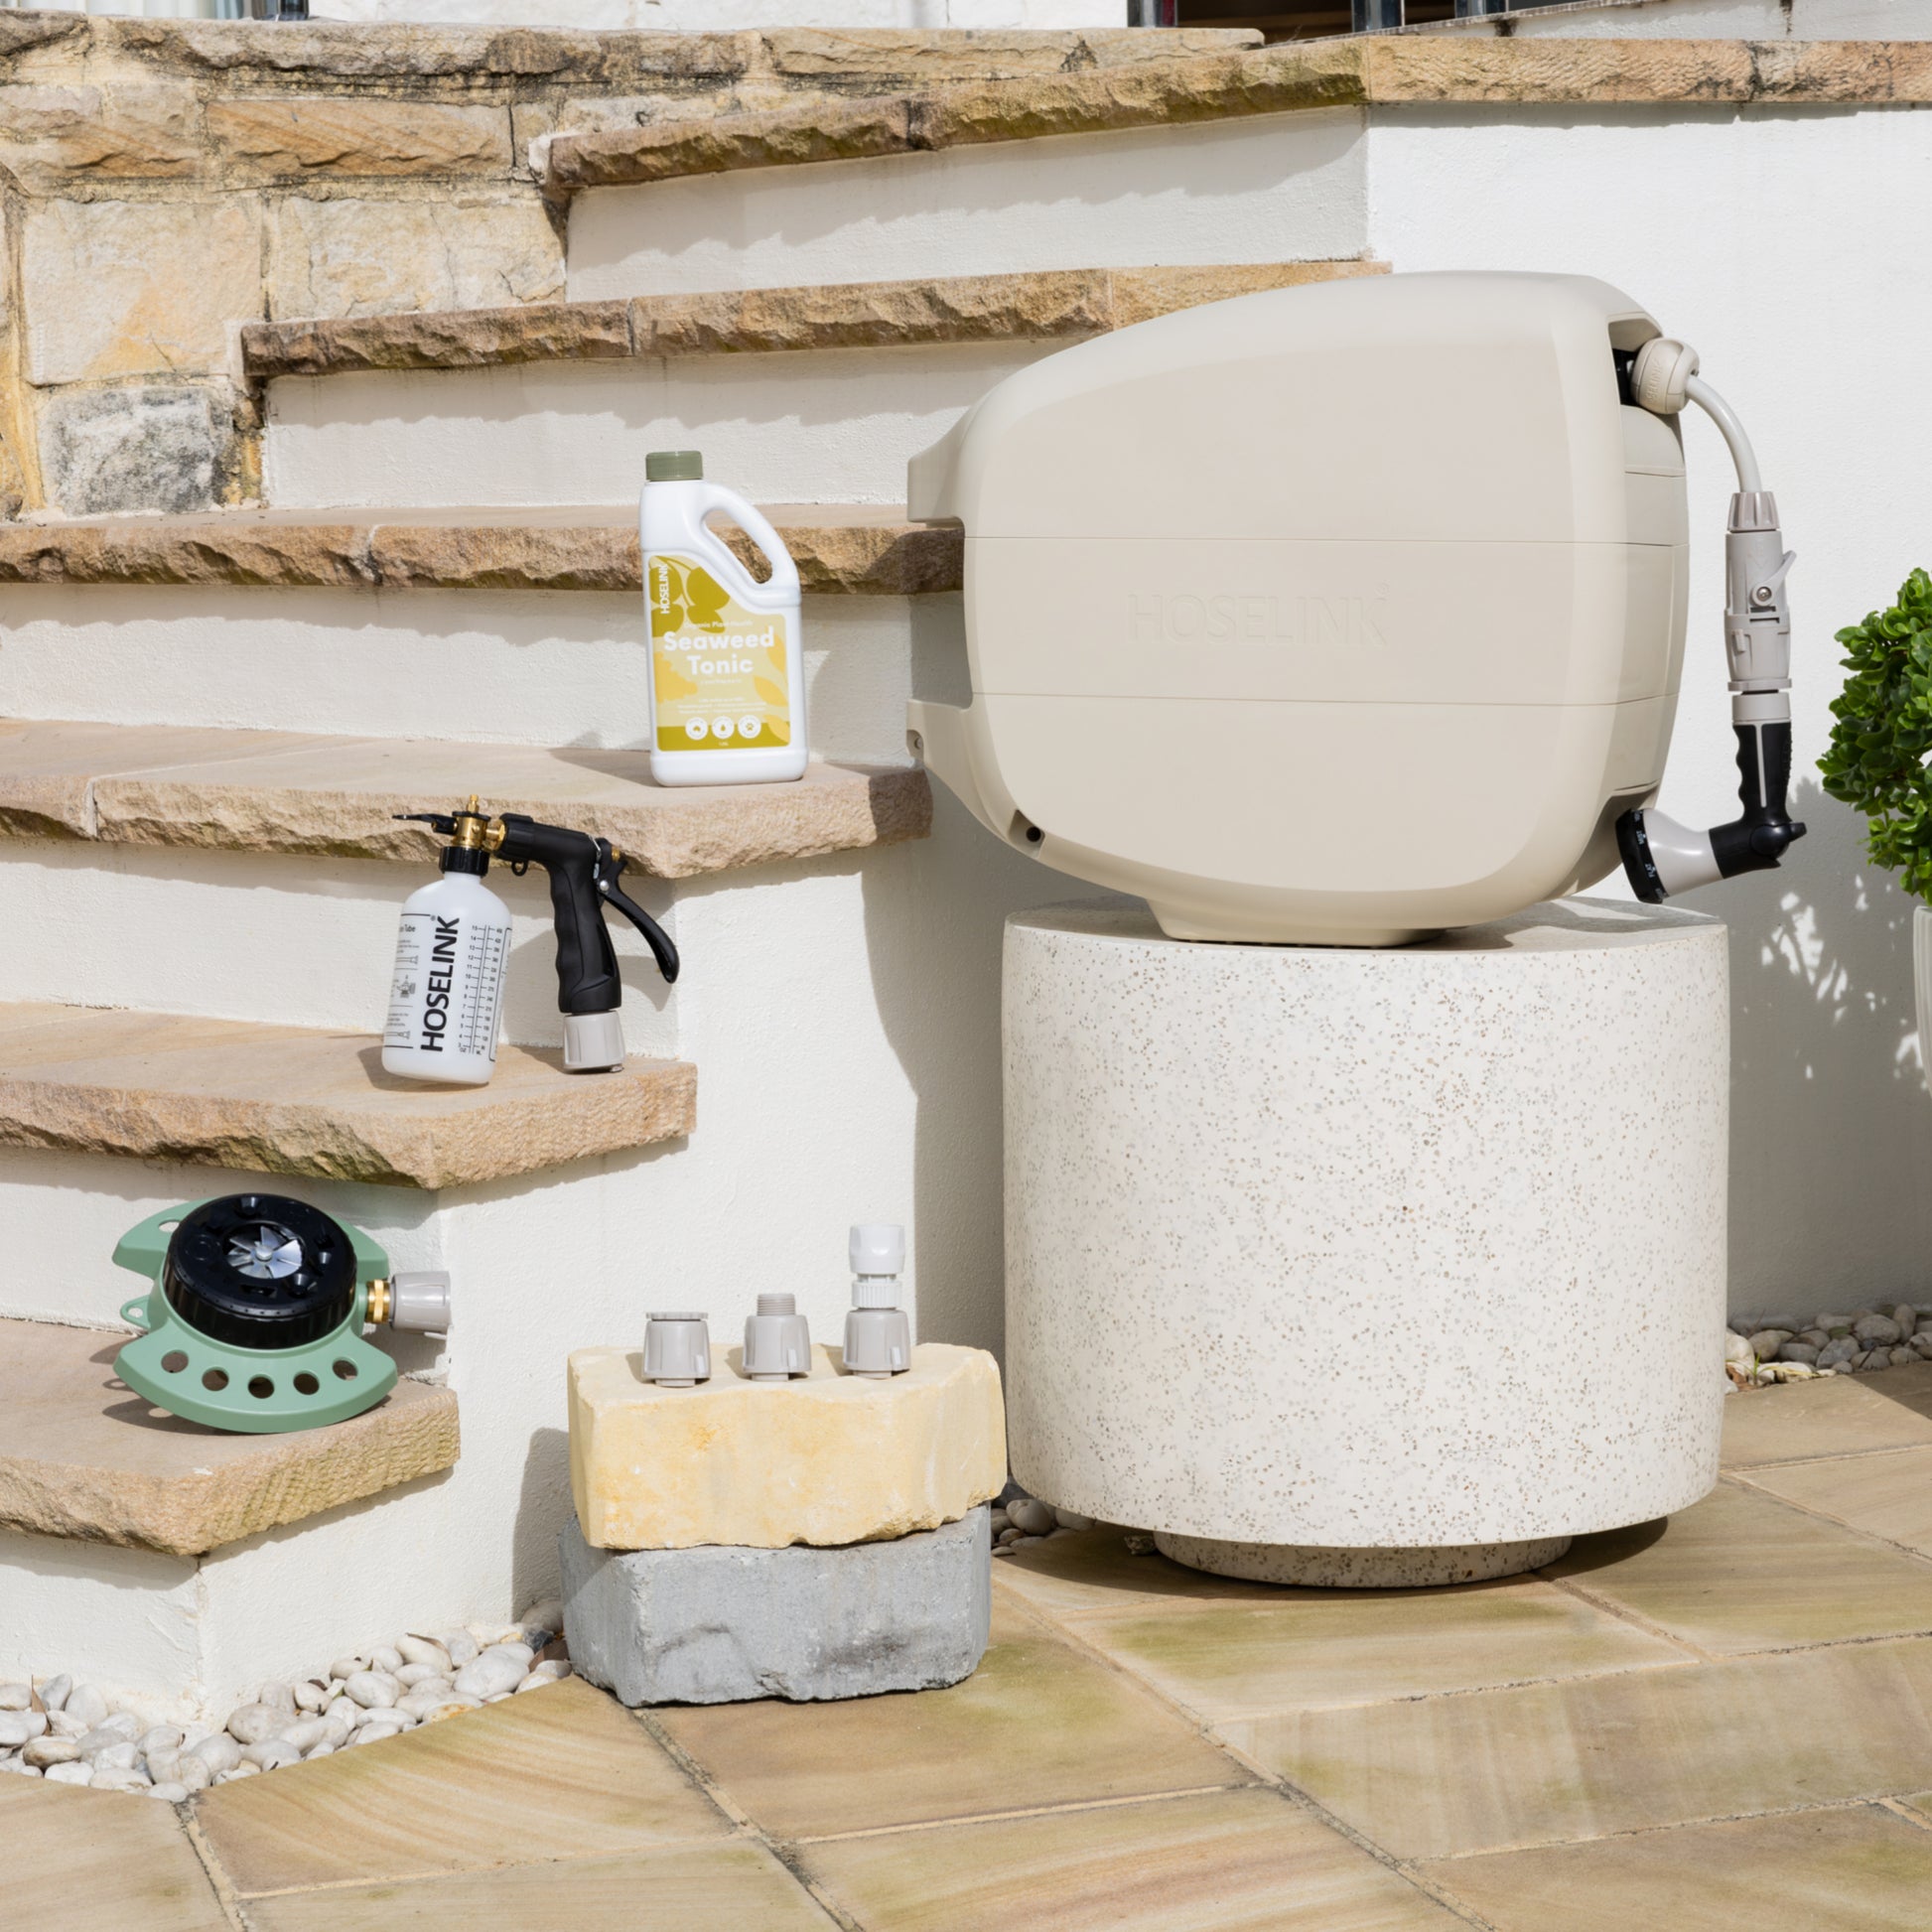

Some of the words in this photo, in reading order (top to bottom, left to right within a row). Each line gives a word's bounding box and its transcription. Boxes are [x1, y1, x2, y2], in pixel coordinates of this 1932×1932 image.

[658, 564, 670, 615] HOSELINK
[663, 625, 774, 651] Seaweed
[1126, 594, 1388, 647] HOSELINK
[686, 653, 755, 675] Tonic
[420, 915, 460, 1052] HOSELINK
